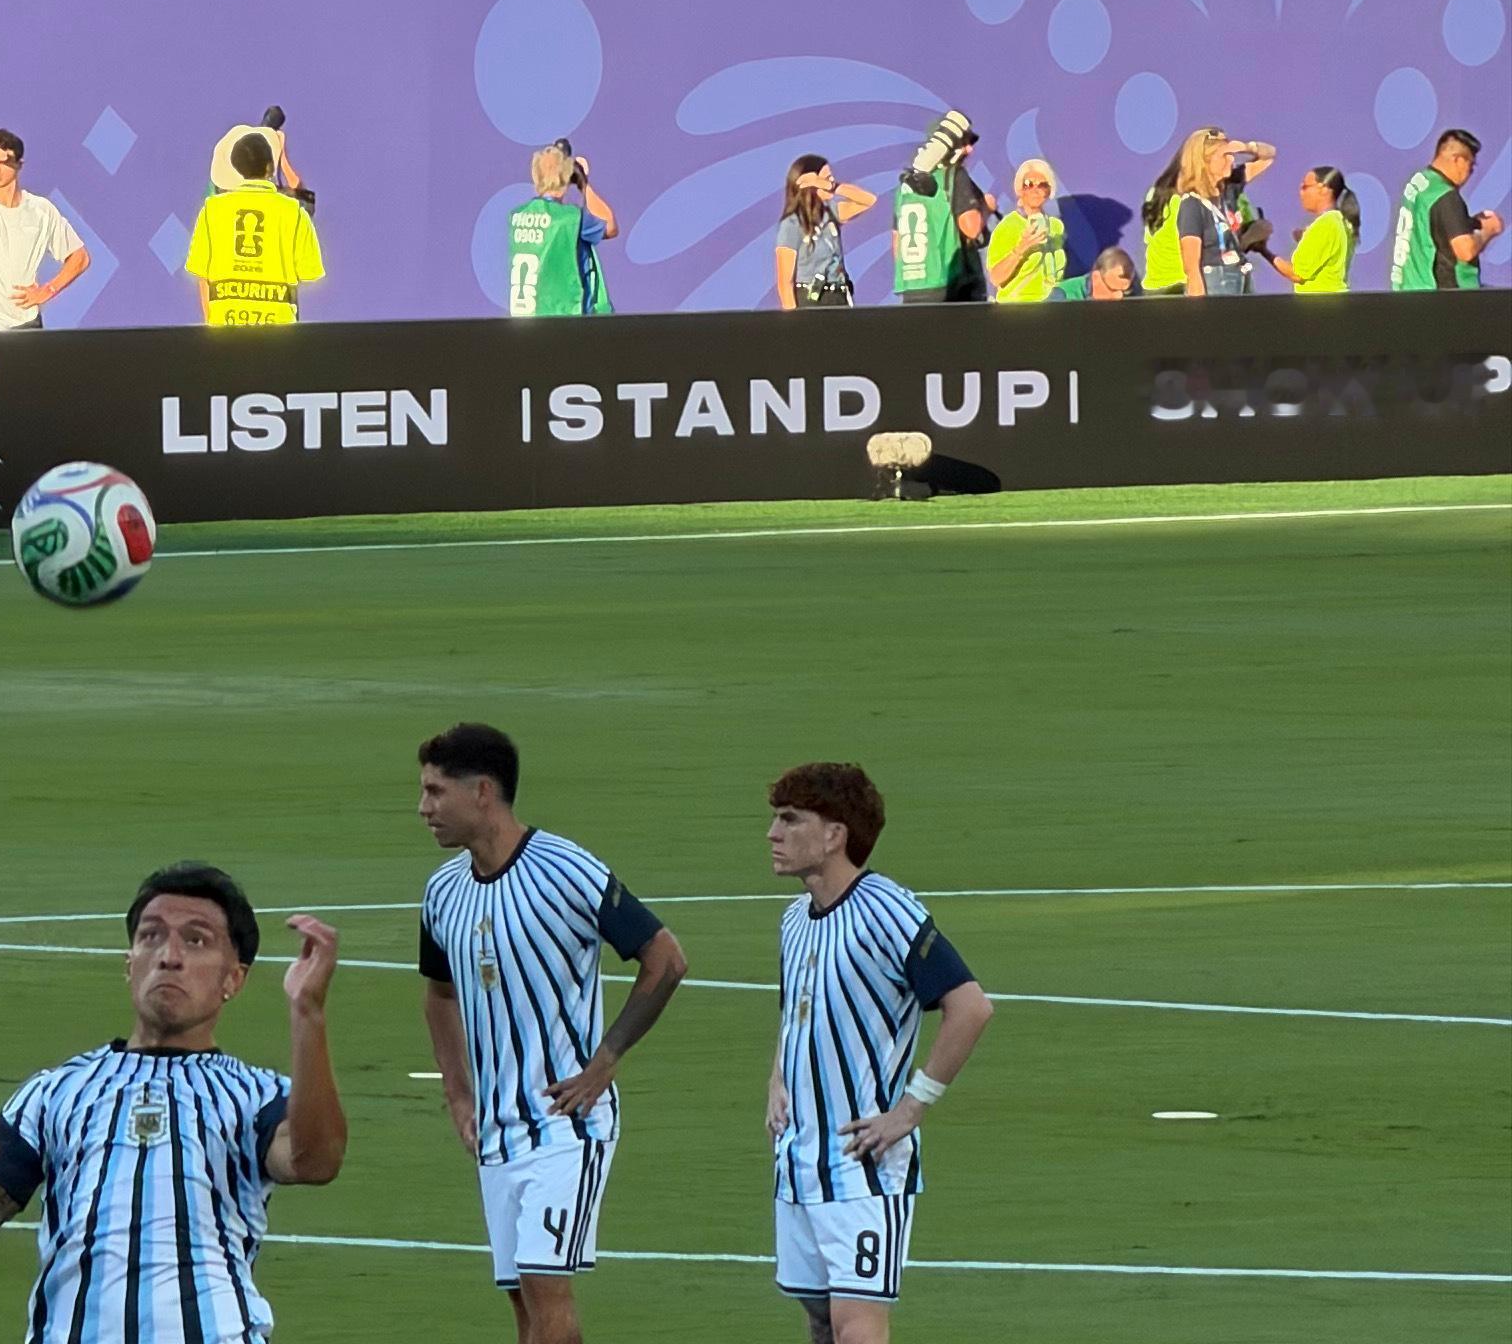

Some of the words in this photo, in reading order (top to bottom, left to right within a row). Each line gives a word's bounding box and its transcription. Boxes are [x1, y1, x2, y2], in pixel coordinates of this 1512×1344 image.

[216, 283, 288, 301] SECURITY
[162, 389, 448, 454] LISTEN
[549, 376, 881, 442] STAND
[925, 370, 1050, 429] UP
[543, 1206, 567, 1257] 4
[854, 1229, 880, 1279] 8
